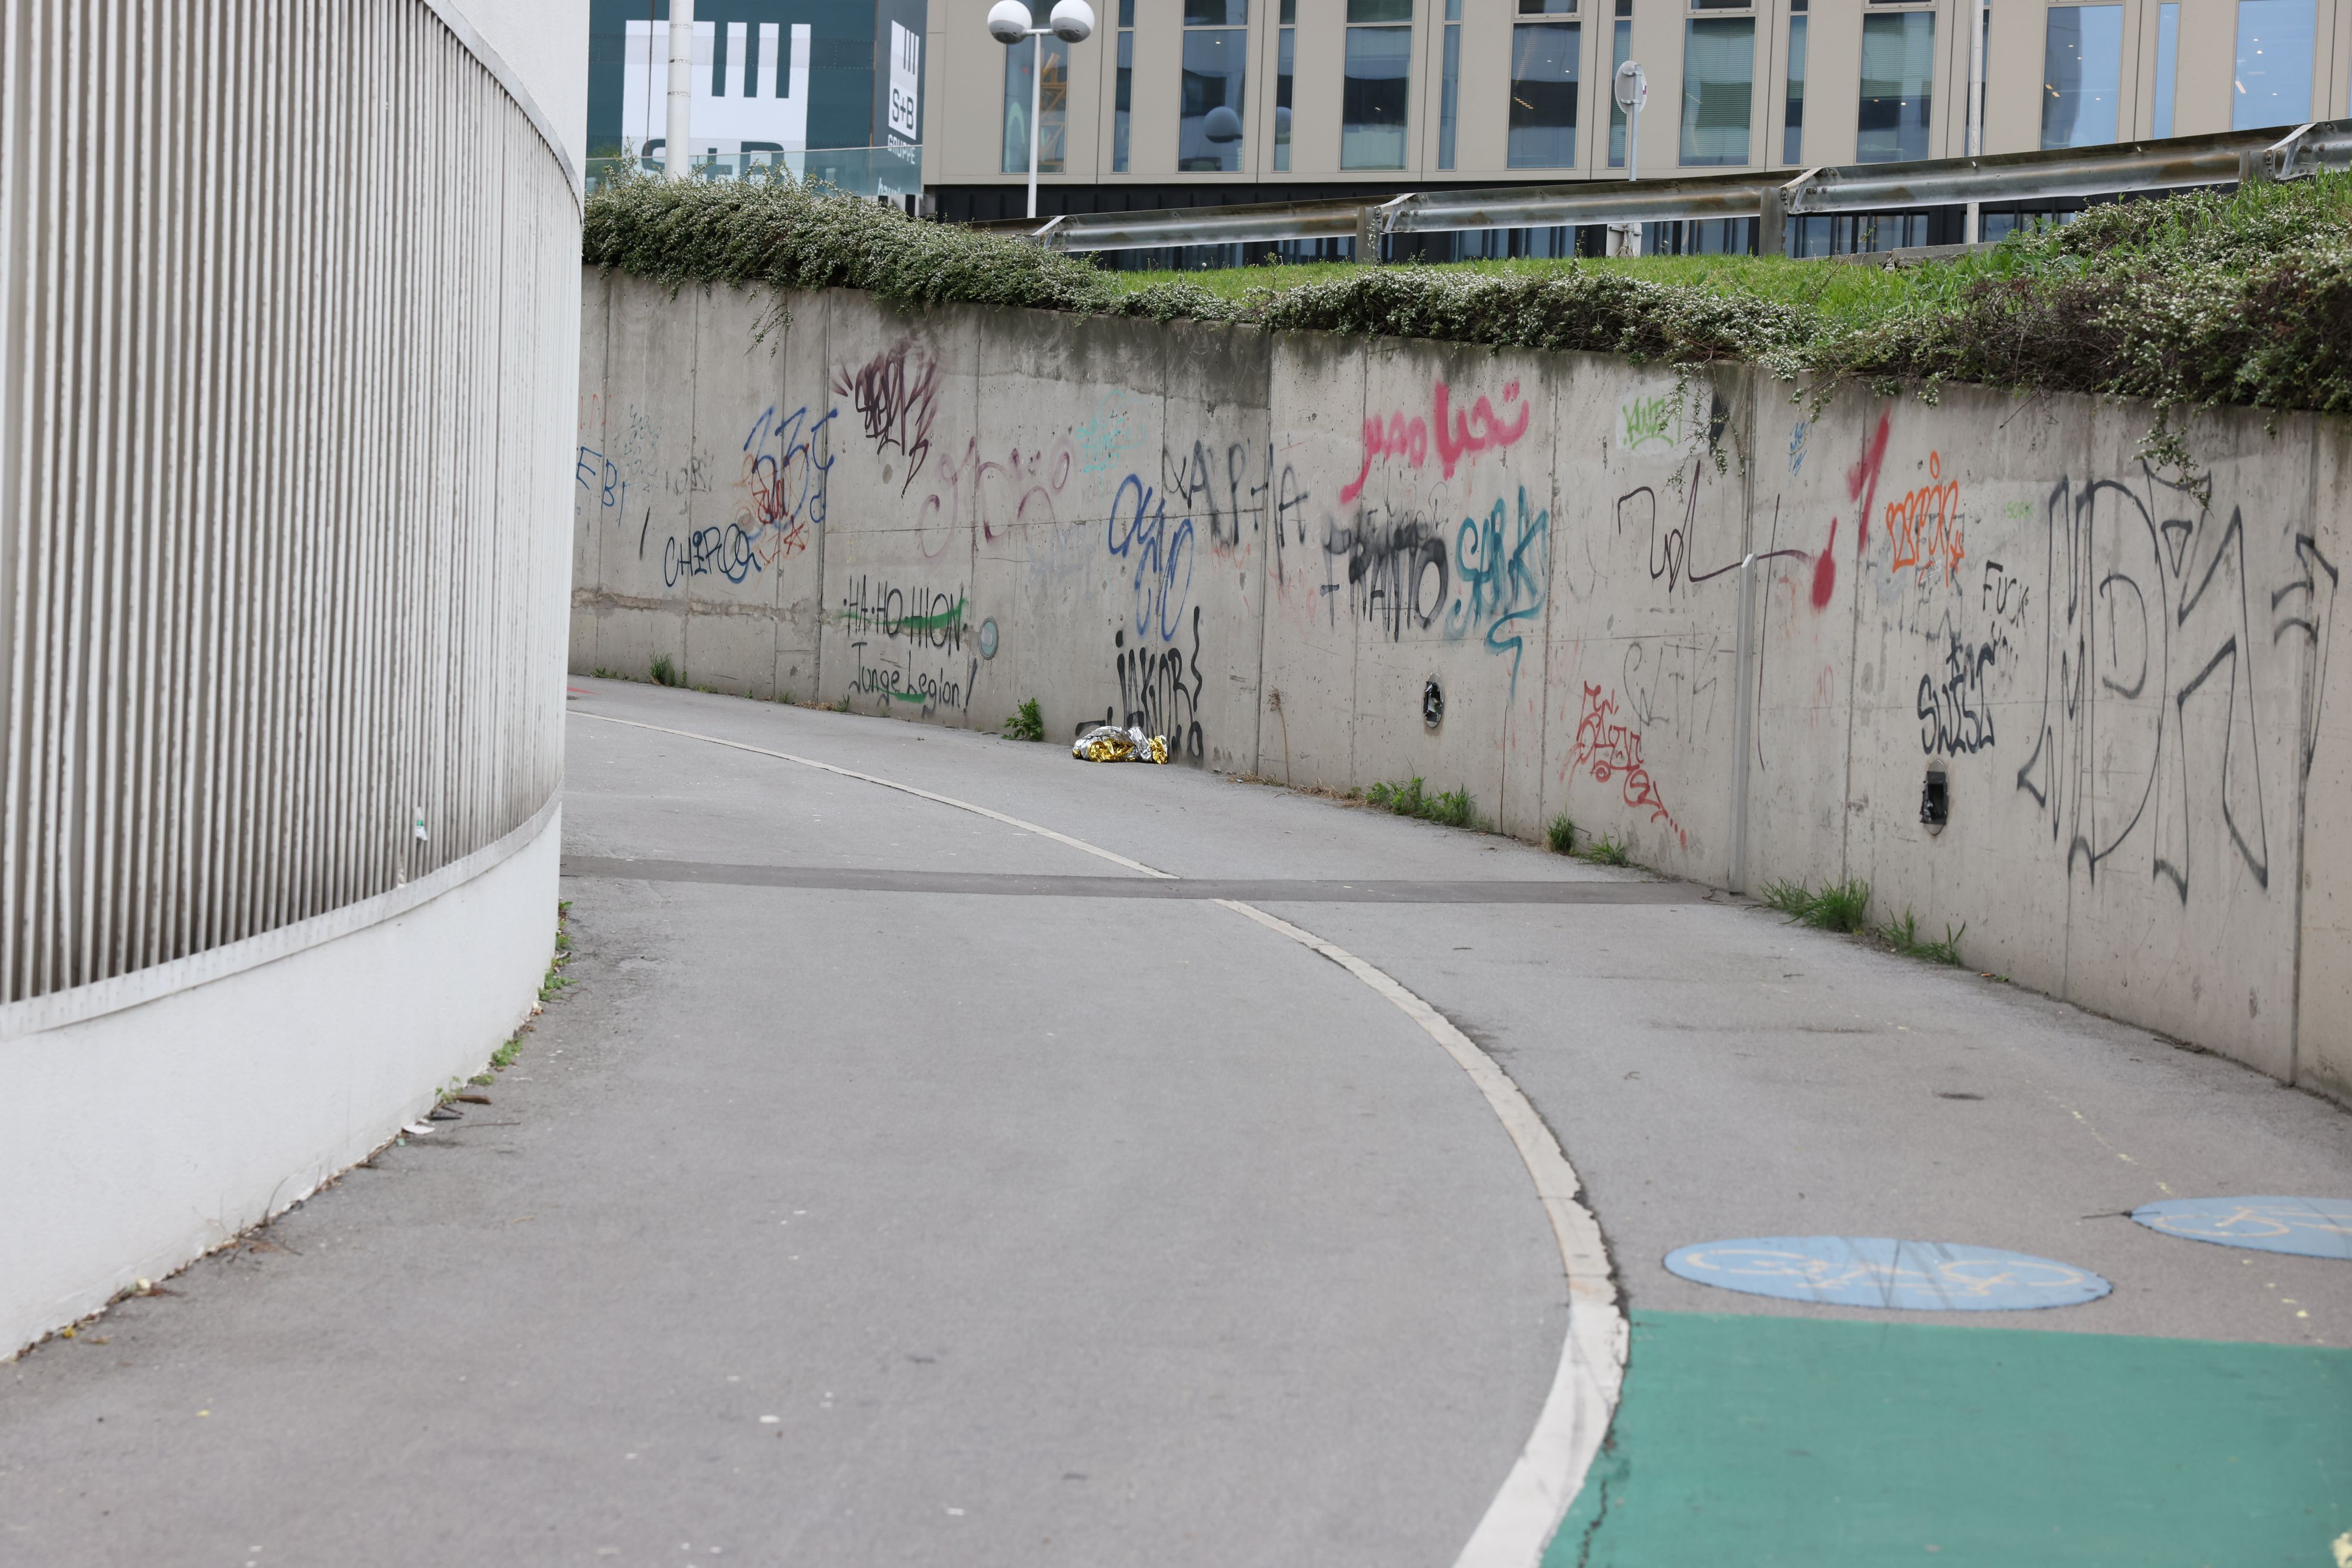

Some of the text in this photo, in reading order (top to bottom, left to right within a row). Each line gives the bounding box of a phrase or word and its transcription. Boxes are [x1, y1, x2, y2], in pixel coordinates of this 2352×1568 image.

[892, 88, 914, 131] S+B
[887, 134, 916, 165] GRUPPE
[1983, 560, 2029, 629] FUCK
[848, 641, 901, 708] Junge
